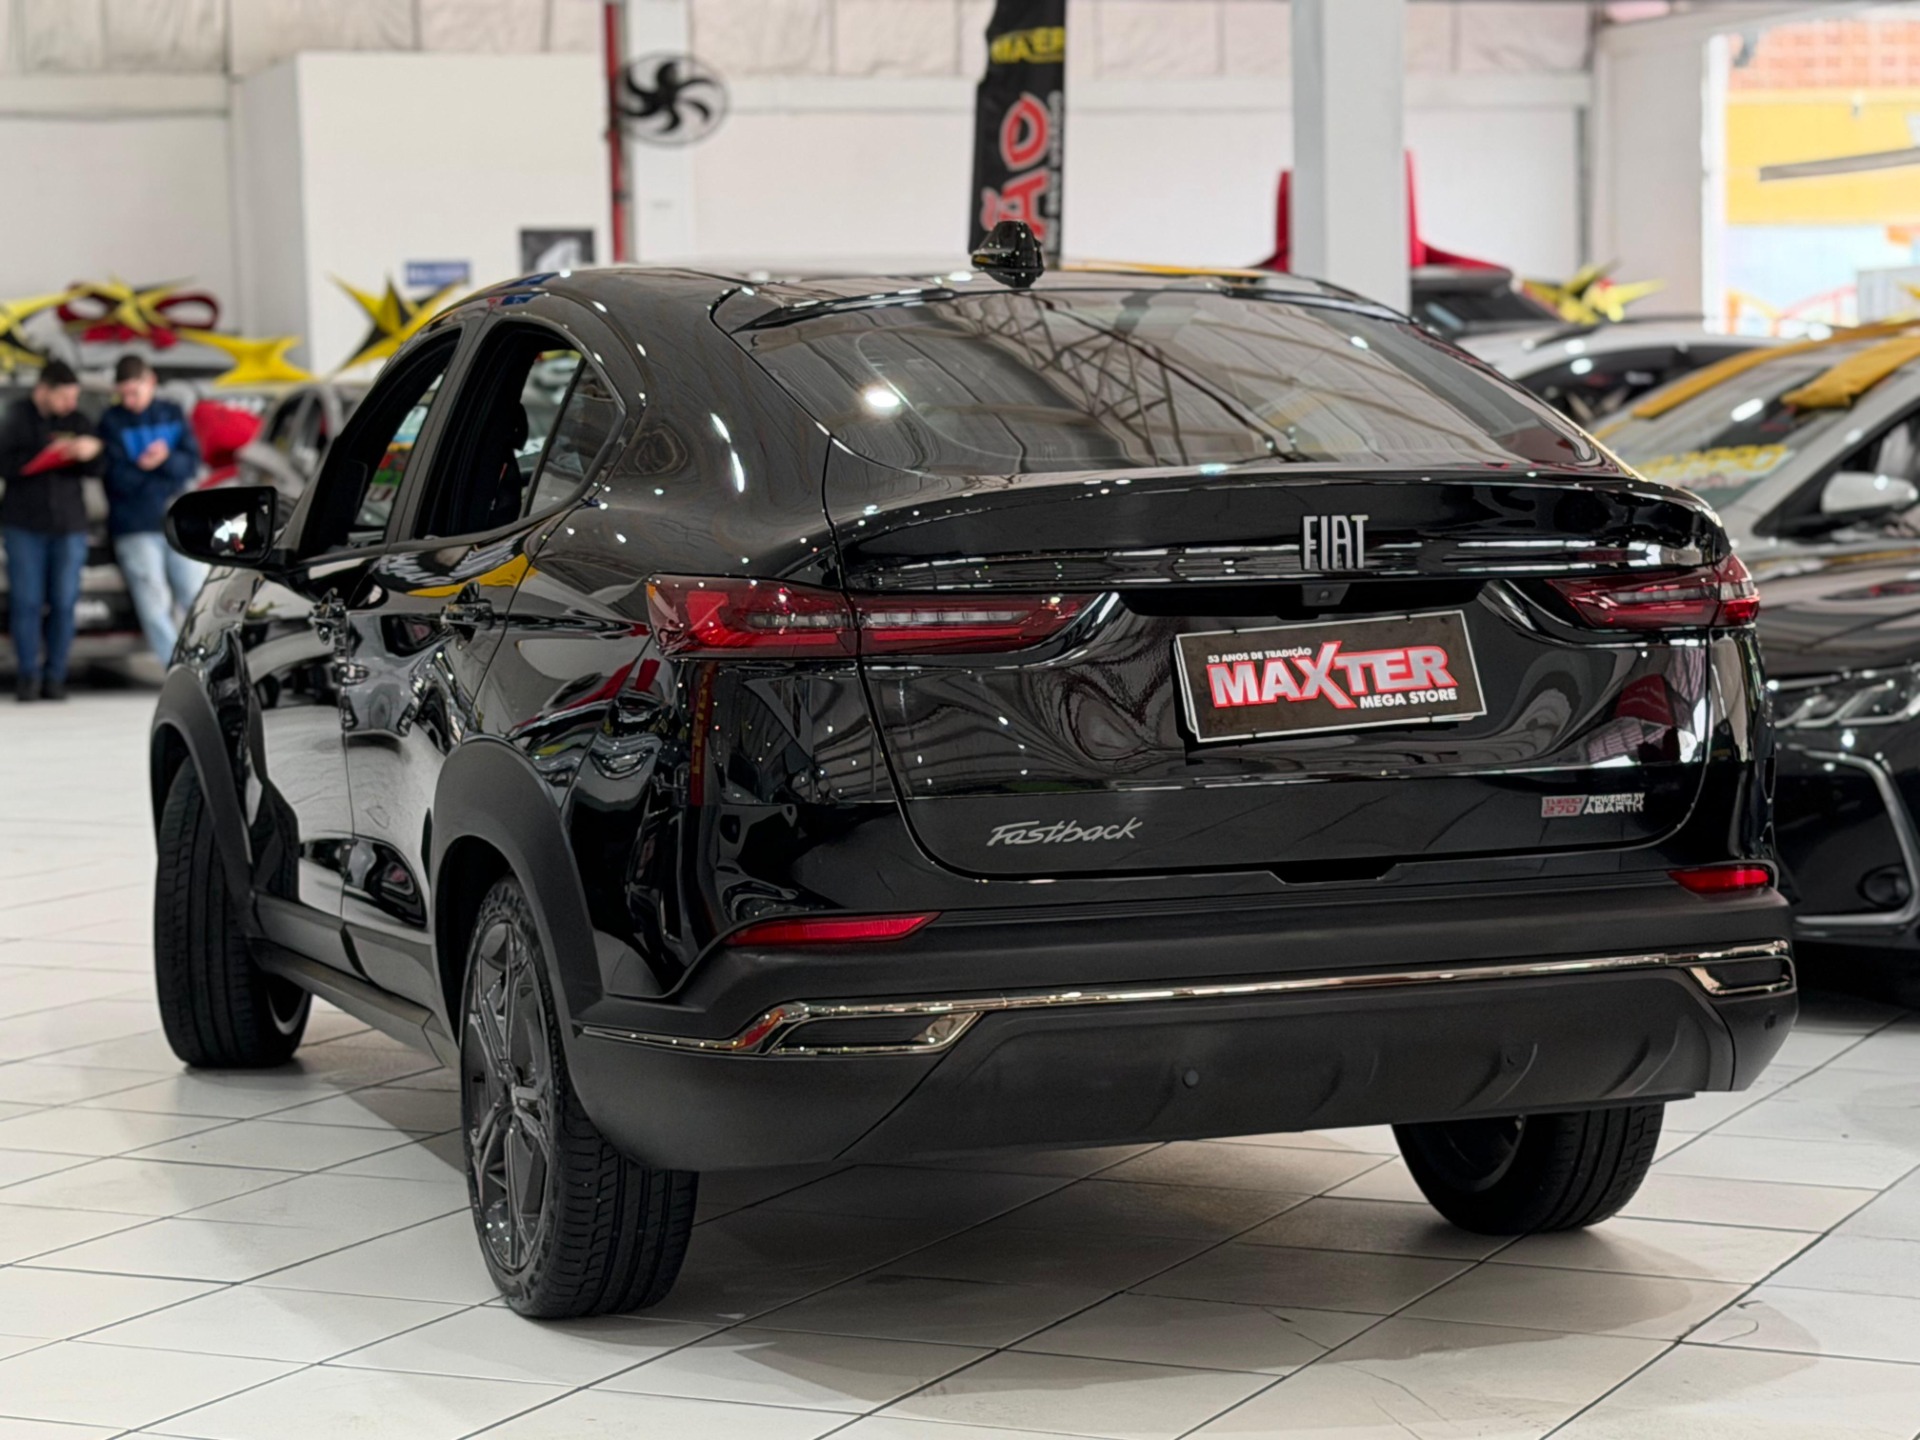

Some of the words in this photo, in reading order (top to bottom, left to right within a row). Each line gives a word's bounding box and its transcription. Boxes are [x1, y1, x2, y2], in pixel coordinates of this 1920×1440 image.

[1302, 514, 1369, 570] FIAT
[1207, 654, 1220, 664] 53
[1221, 652, 1250, 663] ANOS
[1250, 650, 1264, 660] DE
[1264, 646, 1312, 659] TRADIÇÃO
[1206, 641, 1458, 709] MAXTER
[1360, 692, 1407, 709] MEGA
[1409, 687, 1458, 705] STORE
[1543, 805, 1577, 815] 270
[1583, 802, 1643, 815] ABARTH
[986, 816, 1143, 847] Fastback
